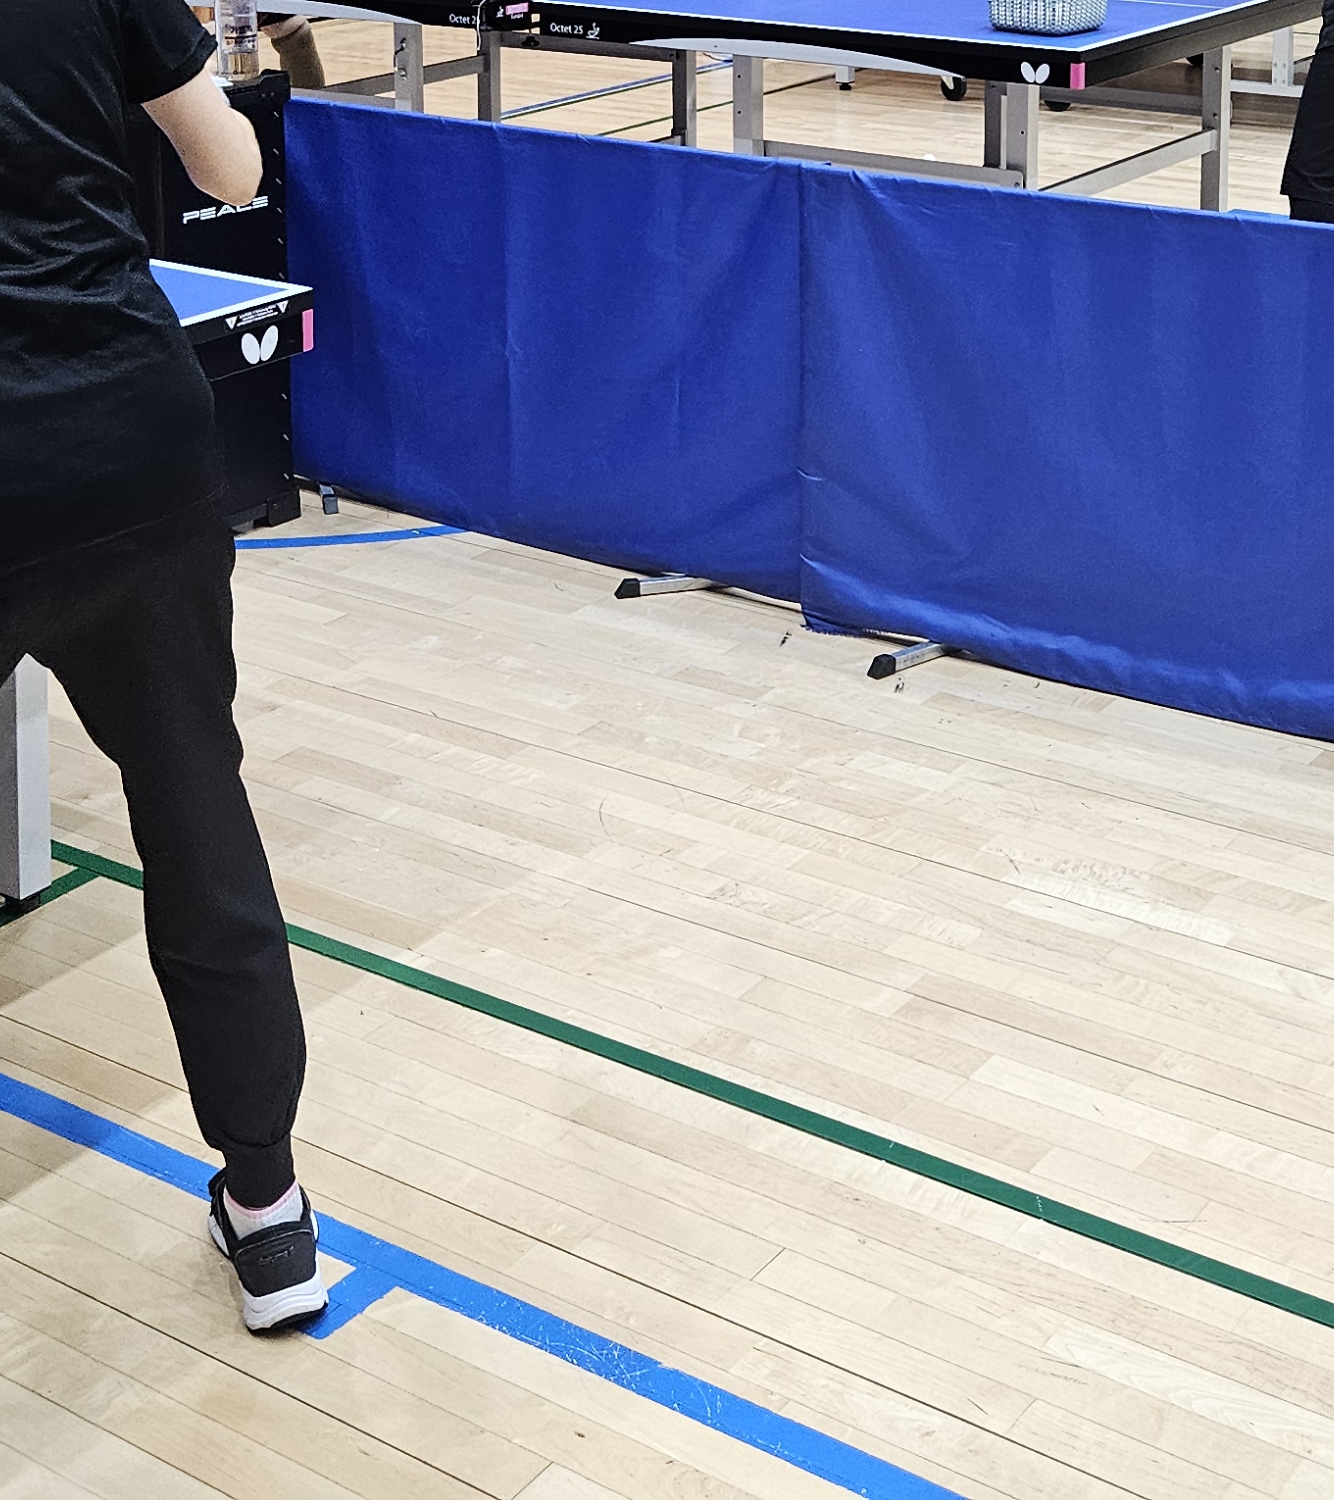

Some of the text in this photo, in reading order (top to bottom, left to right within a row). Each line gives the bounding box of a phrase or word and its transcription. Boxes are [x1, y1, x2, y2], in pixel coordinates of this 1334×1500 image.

[449, 13, 470, 25] Octet
[549, 22, 584, 35] Octet 25
